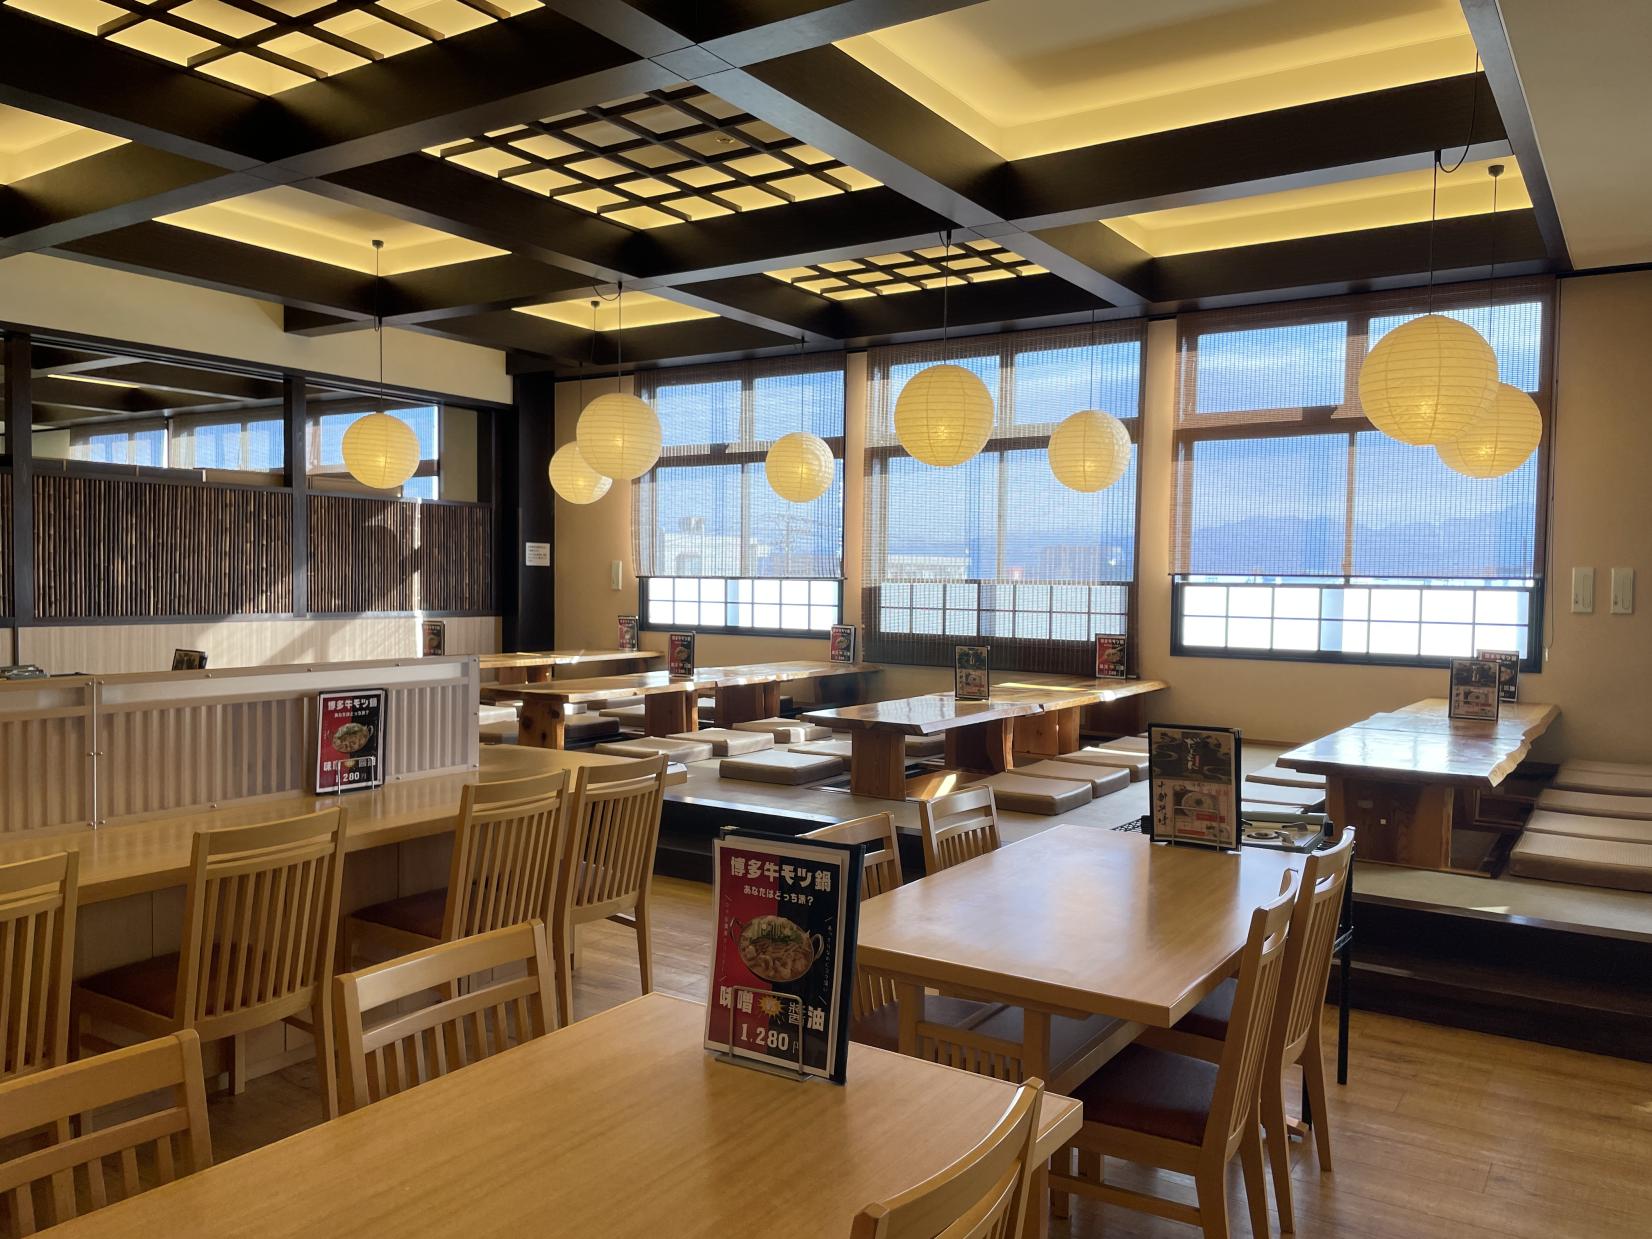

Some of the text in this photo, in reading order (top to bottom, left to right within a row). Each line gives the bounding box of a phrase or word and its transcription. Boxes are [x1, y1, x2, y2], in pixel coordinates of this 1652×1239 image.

[730, 856, 831, 892] 博多牛モツ鍋
